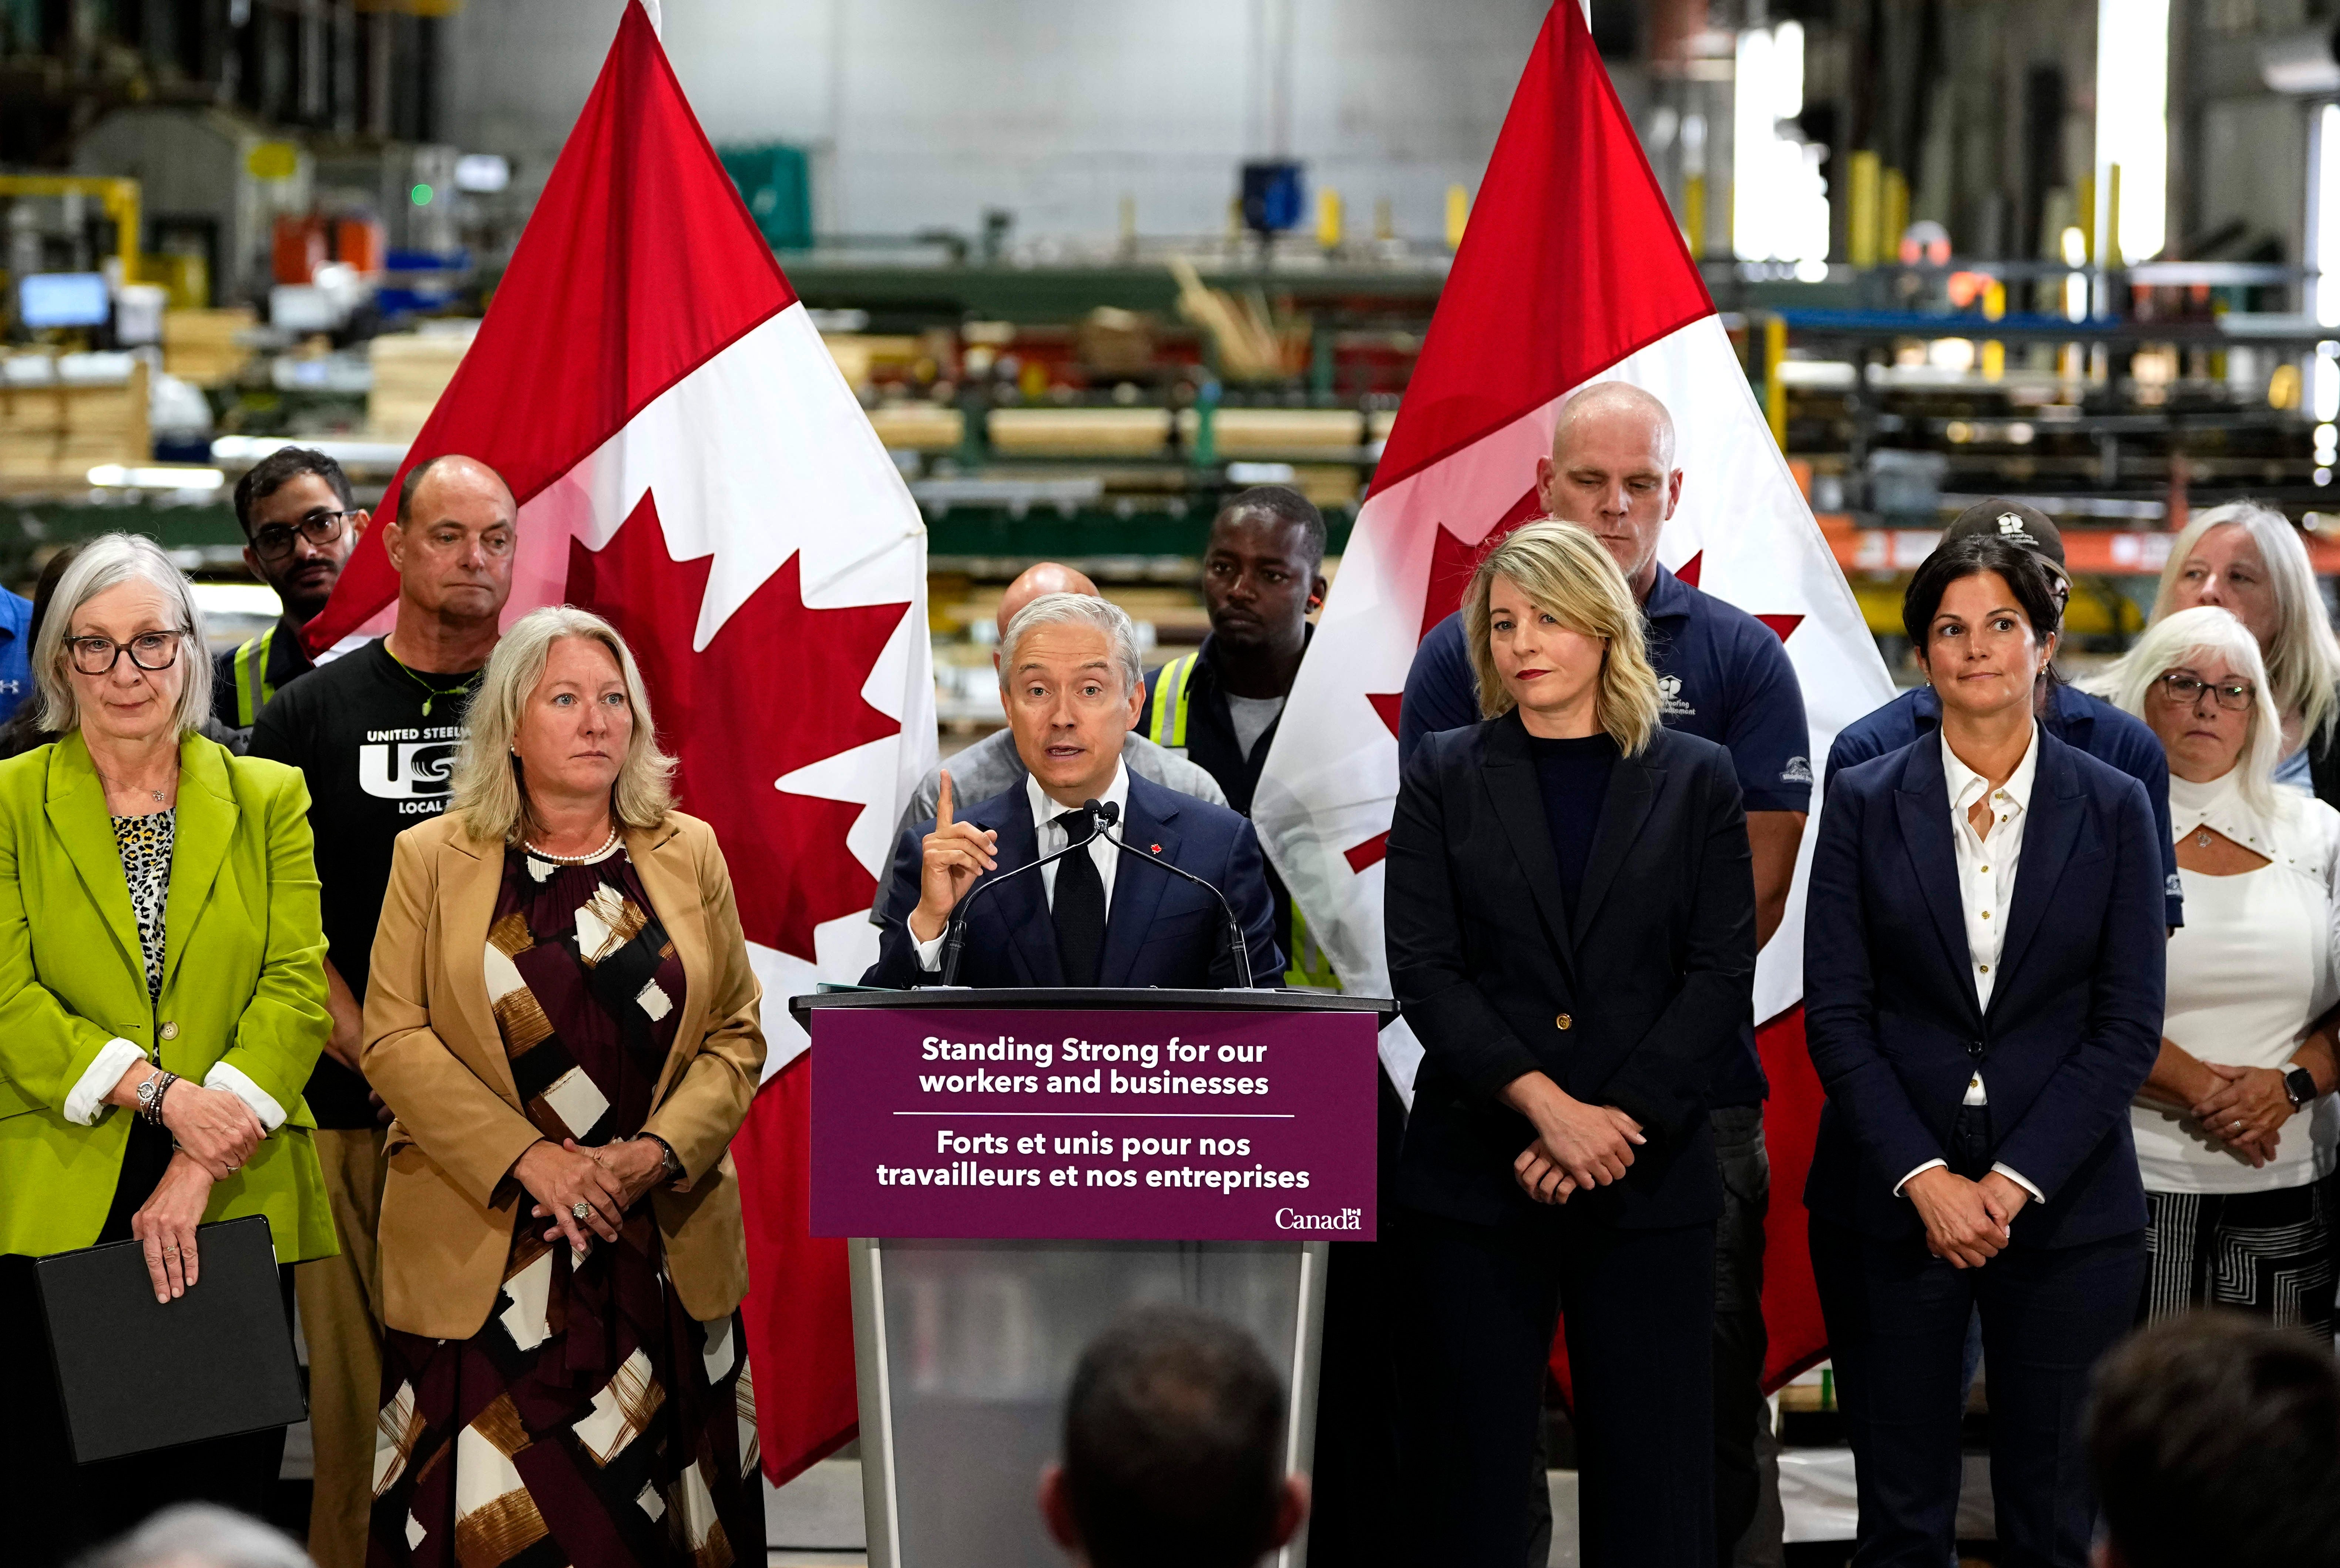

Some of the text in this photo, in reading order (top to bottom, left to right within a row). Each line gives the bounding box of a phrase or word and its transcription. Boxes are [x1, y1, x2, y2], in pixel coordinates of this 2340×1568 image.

[367, 728, 419, 742] UNITED
[399, 800, 443, 814] LOCAL
[922, 1036, 1267, 1069] Standing Strong for our
[919, 1068, 1269, 1095] workers and businesses
[938, 1130, 1250, 1162] Forts et unis pour nos
[876, 1161, 1309, 1195] travailleurs et nos entreprises
[1275, 1208, 1362, 1230] Canada
